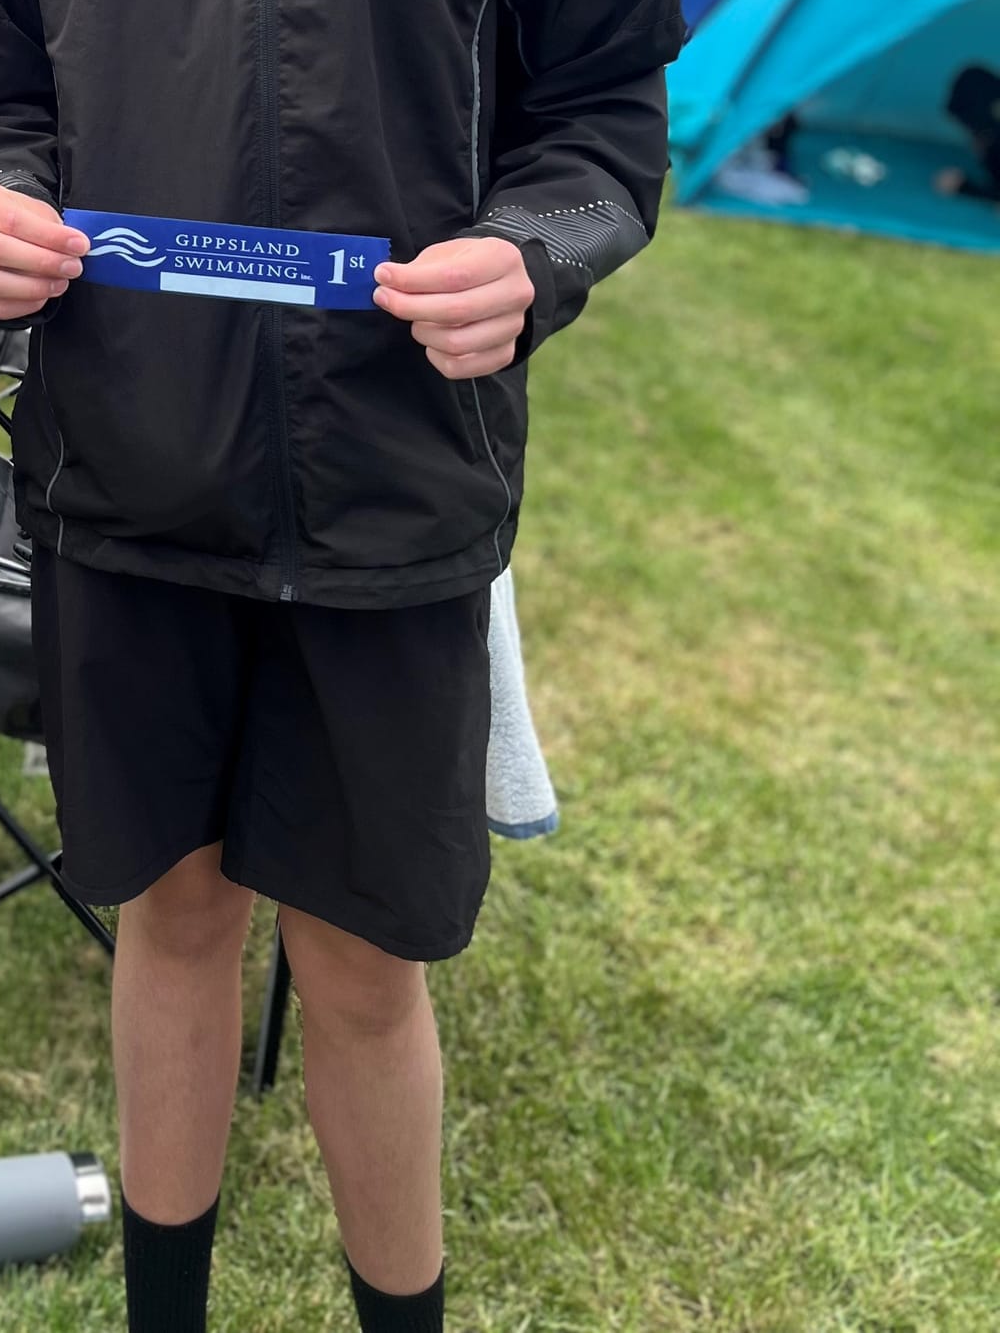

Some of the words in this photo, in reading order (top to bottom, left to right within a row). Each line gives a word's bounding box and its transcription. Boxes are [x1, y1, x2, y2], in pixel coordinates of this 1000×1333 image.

[174, 255, 298, 279] SWIMMING
[175, 233, 300, 257] GIPPSLAND
[327, 248, 366, 285] 1st
